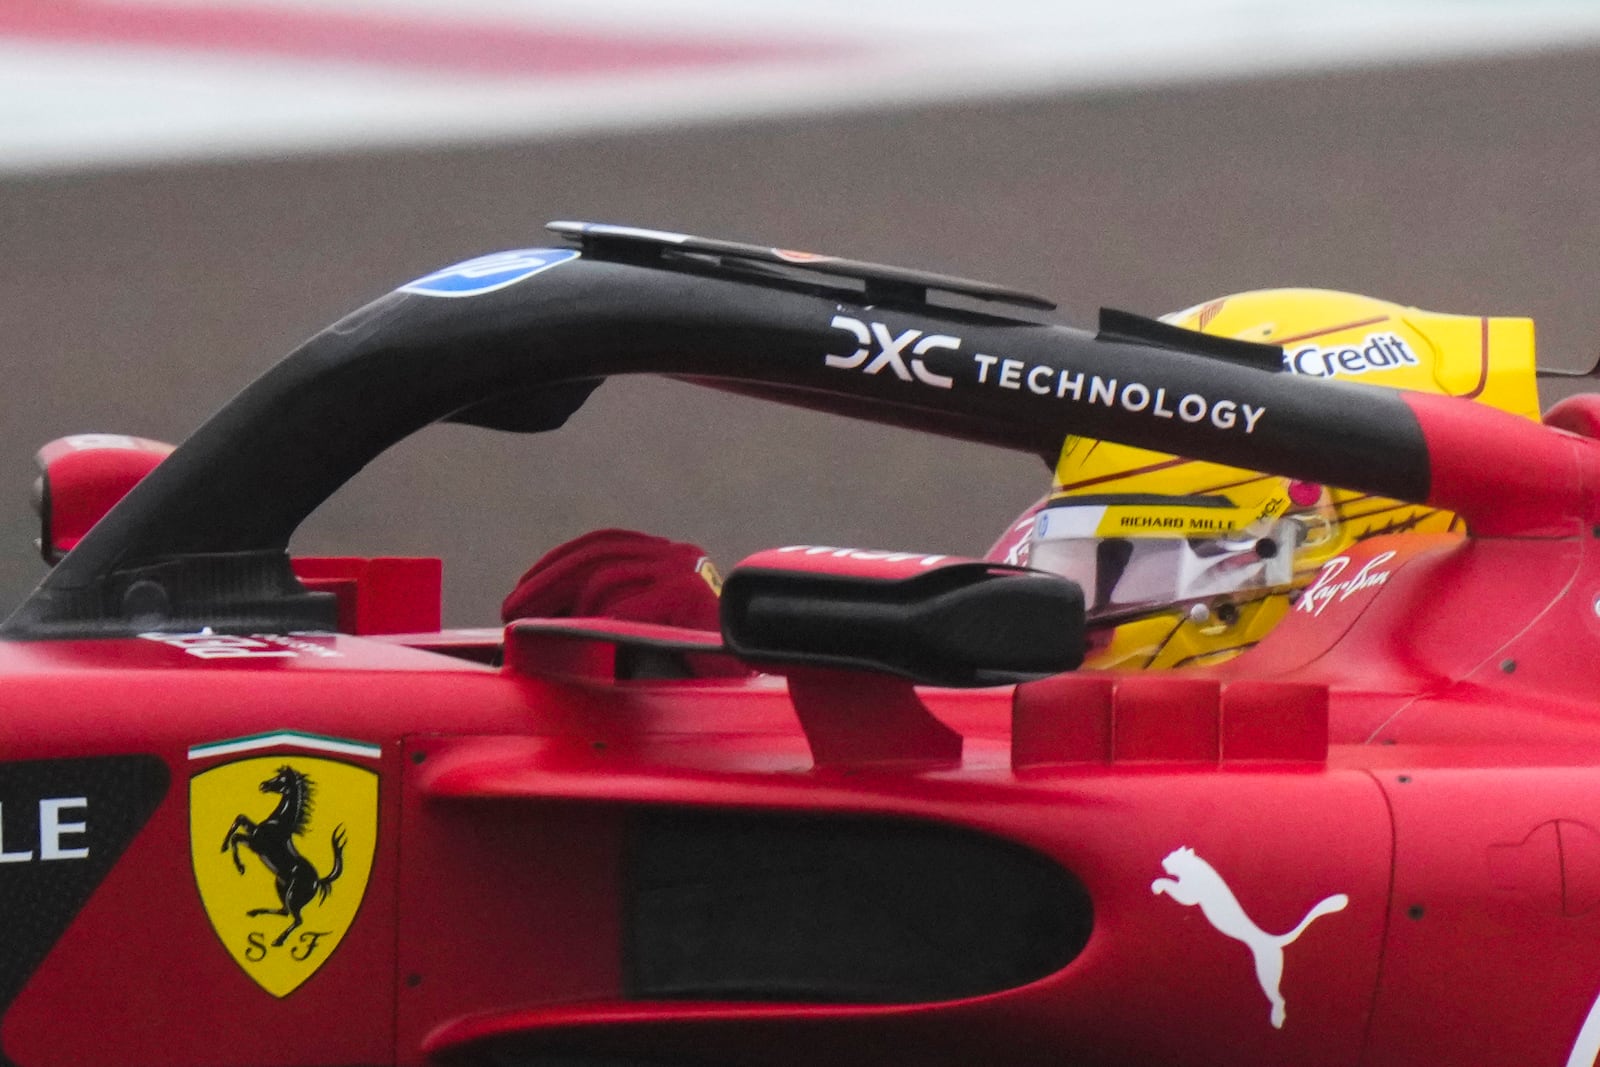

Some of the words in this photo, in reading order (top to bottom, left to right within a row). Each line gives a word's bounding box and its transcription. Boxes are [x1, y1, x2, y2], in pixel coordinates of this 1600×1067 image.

[825, 316, 961, 389] DXC
[974, 354, 1266, 433] TECHNOLOGY
[1120, 516, 1184, 528] RICHARD
[1189, 518, 1237, 529] MILLE
[1297, 551, 1396, 617] Ray-Ban
[245, 932, 267, 962] S
[291, 931, 333, 962] F
